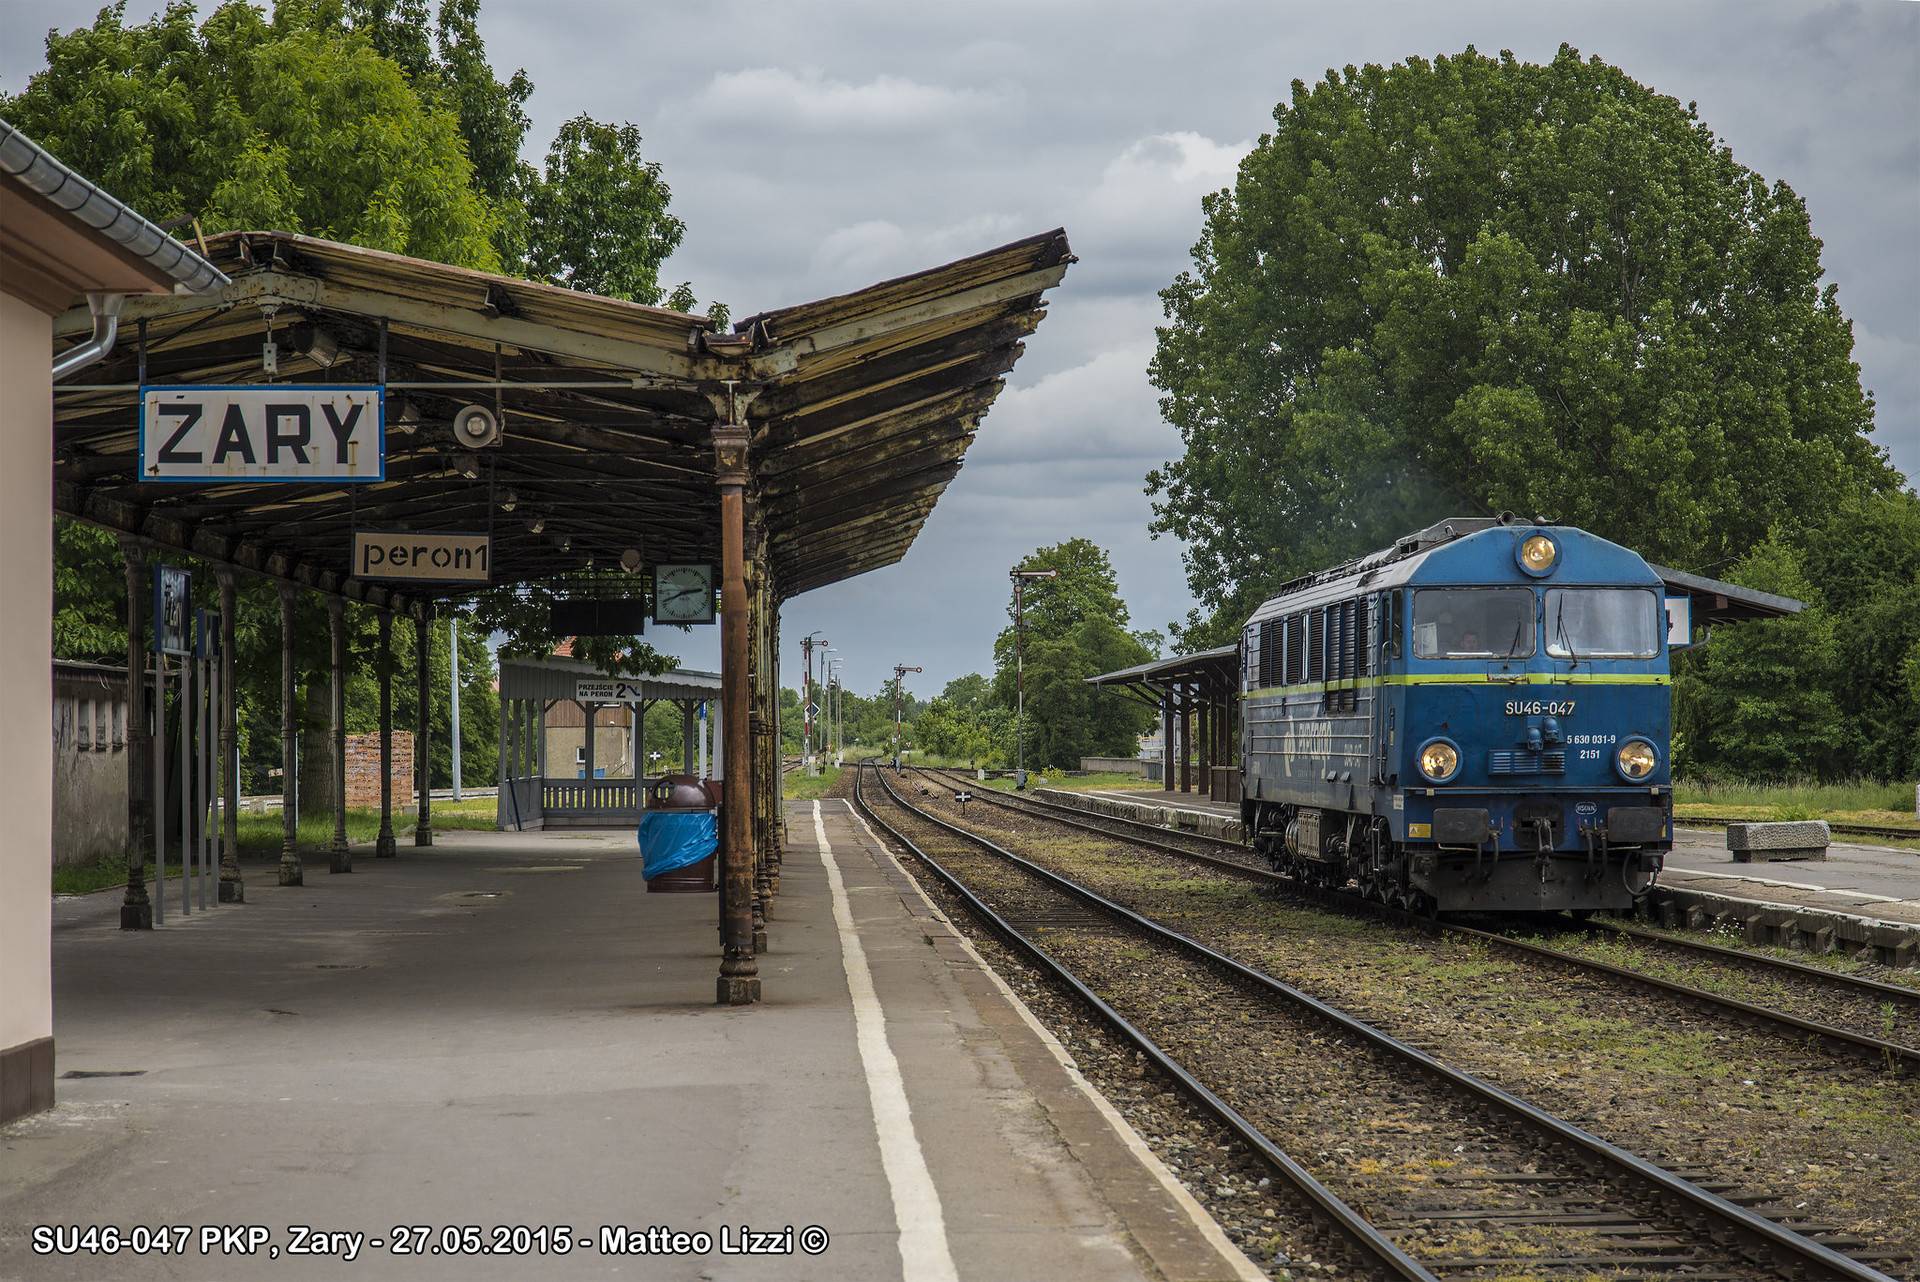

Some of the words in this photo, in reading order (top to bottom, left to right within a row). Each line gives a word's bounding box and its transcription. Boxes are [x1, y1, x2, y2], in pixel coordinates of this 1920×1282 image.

[616, 683, 626, 698] 2
[1505, 701, 1576, 715] SU46-047
[1566, 735, 1572, 744] 5
[1574, 735, 1590, 744] 630
[1592, 735, 1616, 744] 031-9
[1580, 750, 1600, 759] 2151
